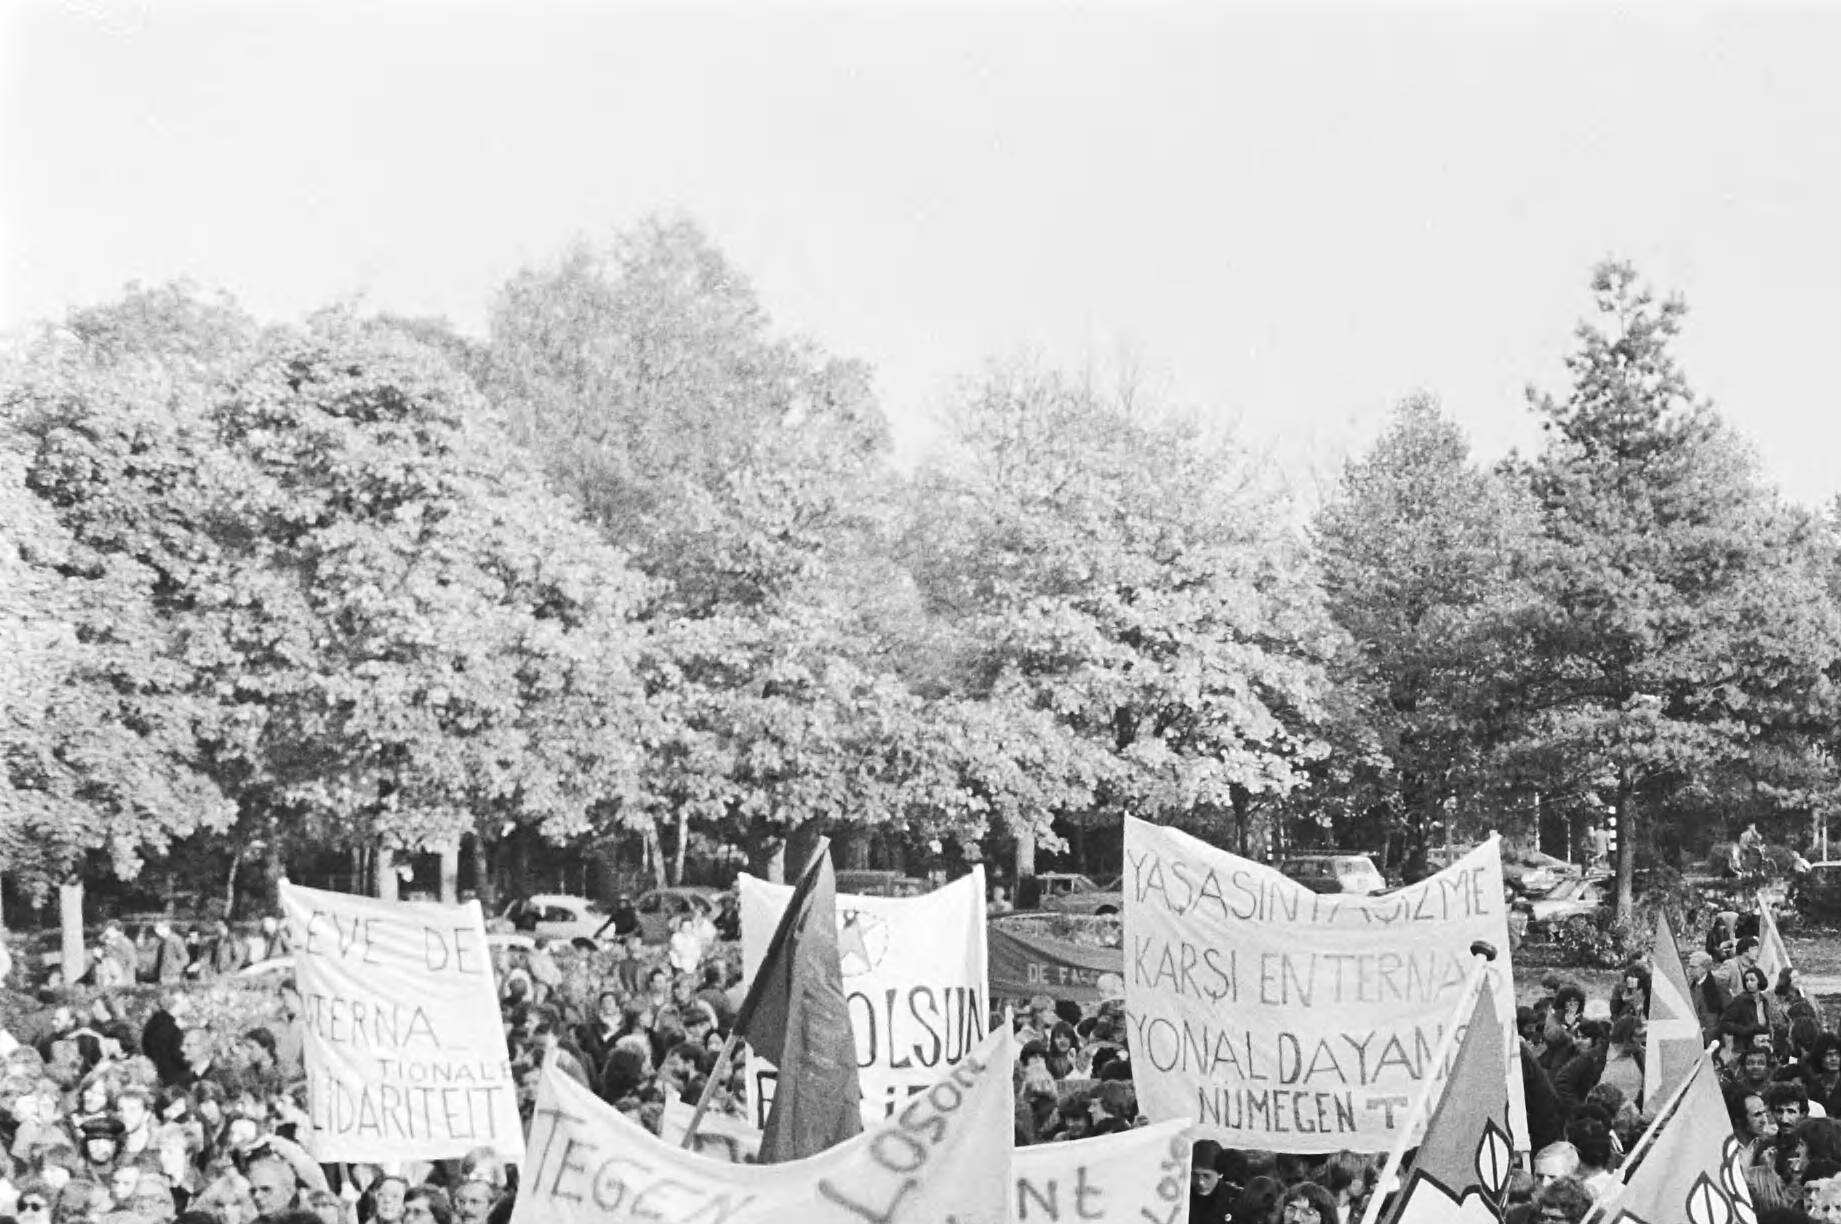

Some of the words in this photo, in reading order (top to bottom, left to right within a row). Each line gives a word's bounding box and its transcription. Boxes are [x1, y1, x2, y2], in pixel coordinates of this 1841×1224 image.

[294, 909, 382, 966] EVE
[424, 925, 486, 974] DE
[1135, 936, 1238, 1004] KARŞI
